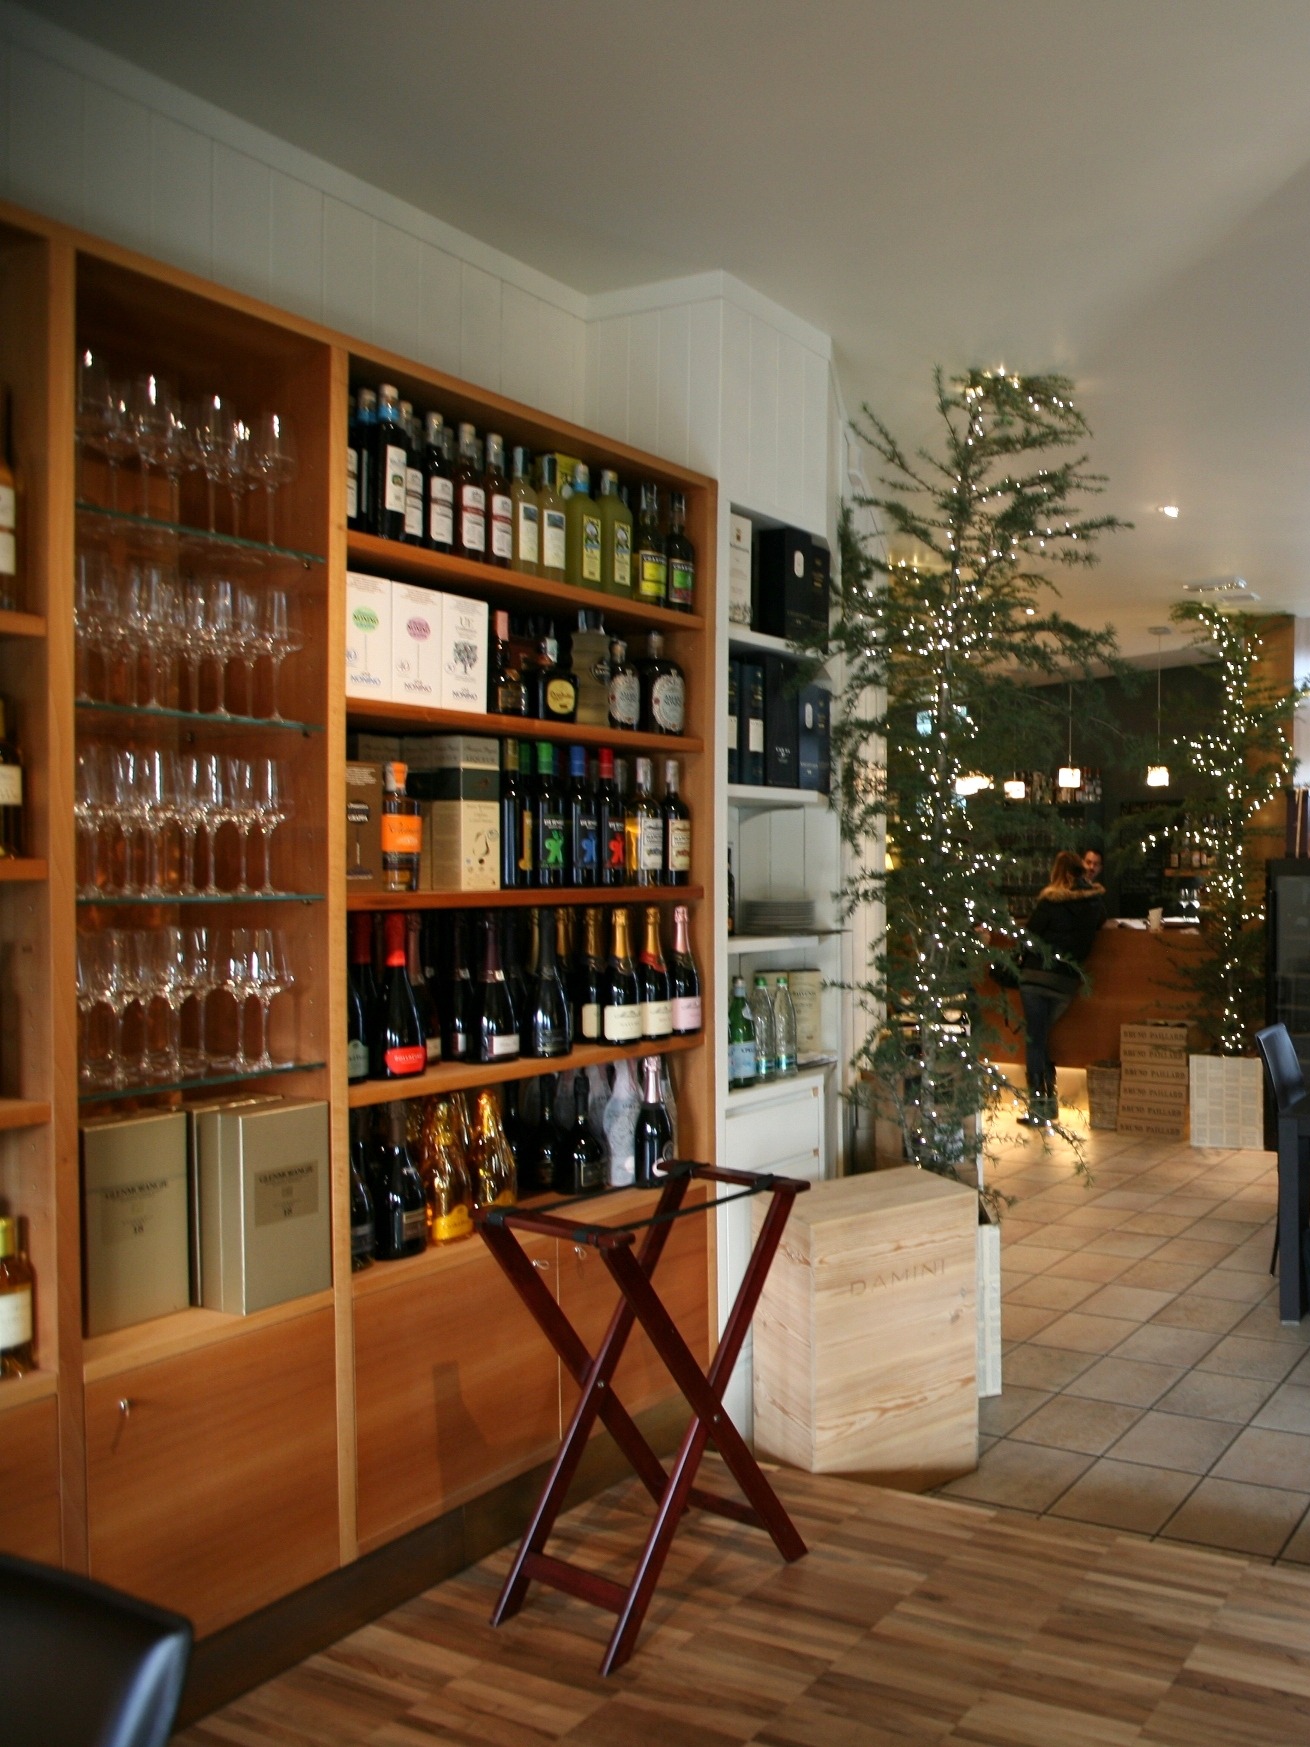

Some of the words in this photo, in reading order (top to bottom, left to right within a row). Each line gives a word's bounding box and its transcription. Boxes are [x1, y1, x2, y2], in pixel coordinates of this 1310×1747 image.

[1123, 1031, 1147, 1039] BRUNO
[1124, 1068, 1147, 1077] BRUNO
[1123, 1087, 1146, 1096] BRUNO
[1121, 1105, 1144, 1113] BRUNO
[1120, 1123, 1143, 1132] BRUNO
[850, 1259, 945, 1296] DAMINI
